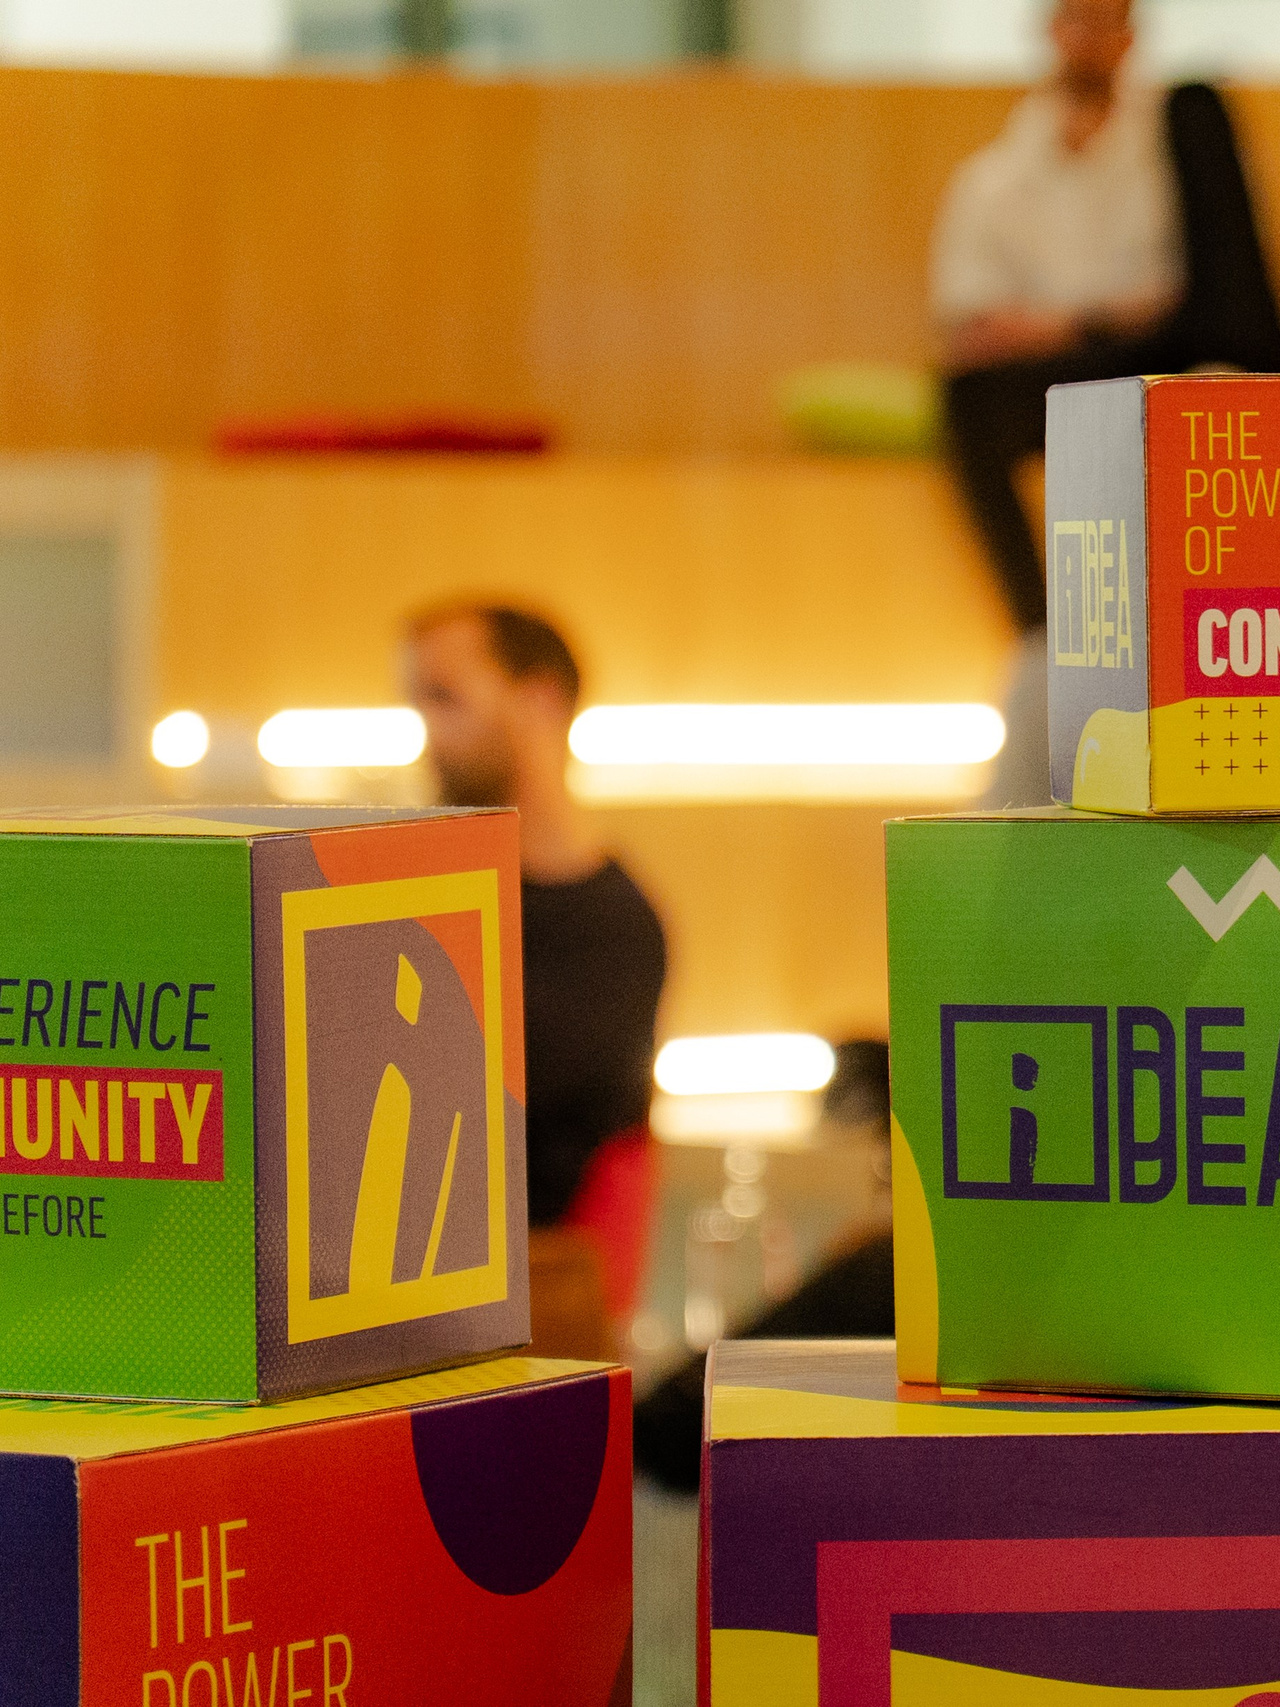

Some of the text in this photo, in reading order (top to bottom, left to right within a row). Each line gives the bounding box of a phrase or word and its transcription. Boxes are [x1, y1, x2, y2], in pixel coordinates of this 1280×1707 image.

[1181, 411, 1261, 460] THE
[1185, 526, 1237, 575] OF
[0, 979, 215, 1052] ERIENCE
[0, 1077, 213, 1165] UNITY
[3, 1194, 107, 1239] EFORE
[135, 1518, 253, 1648] THE
[143, 1633, 353, 1707] WER
